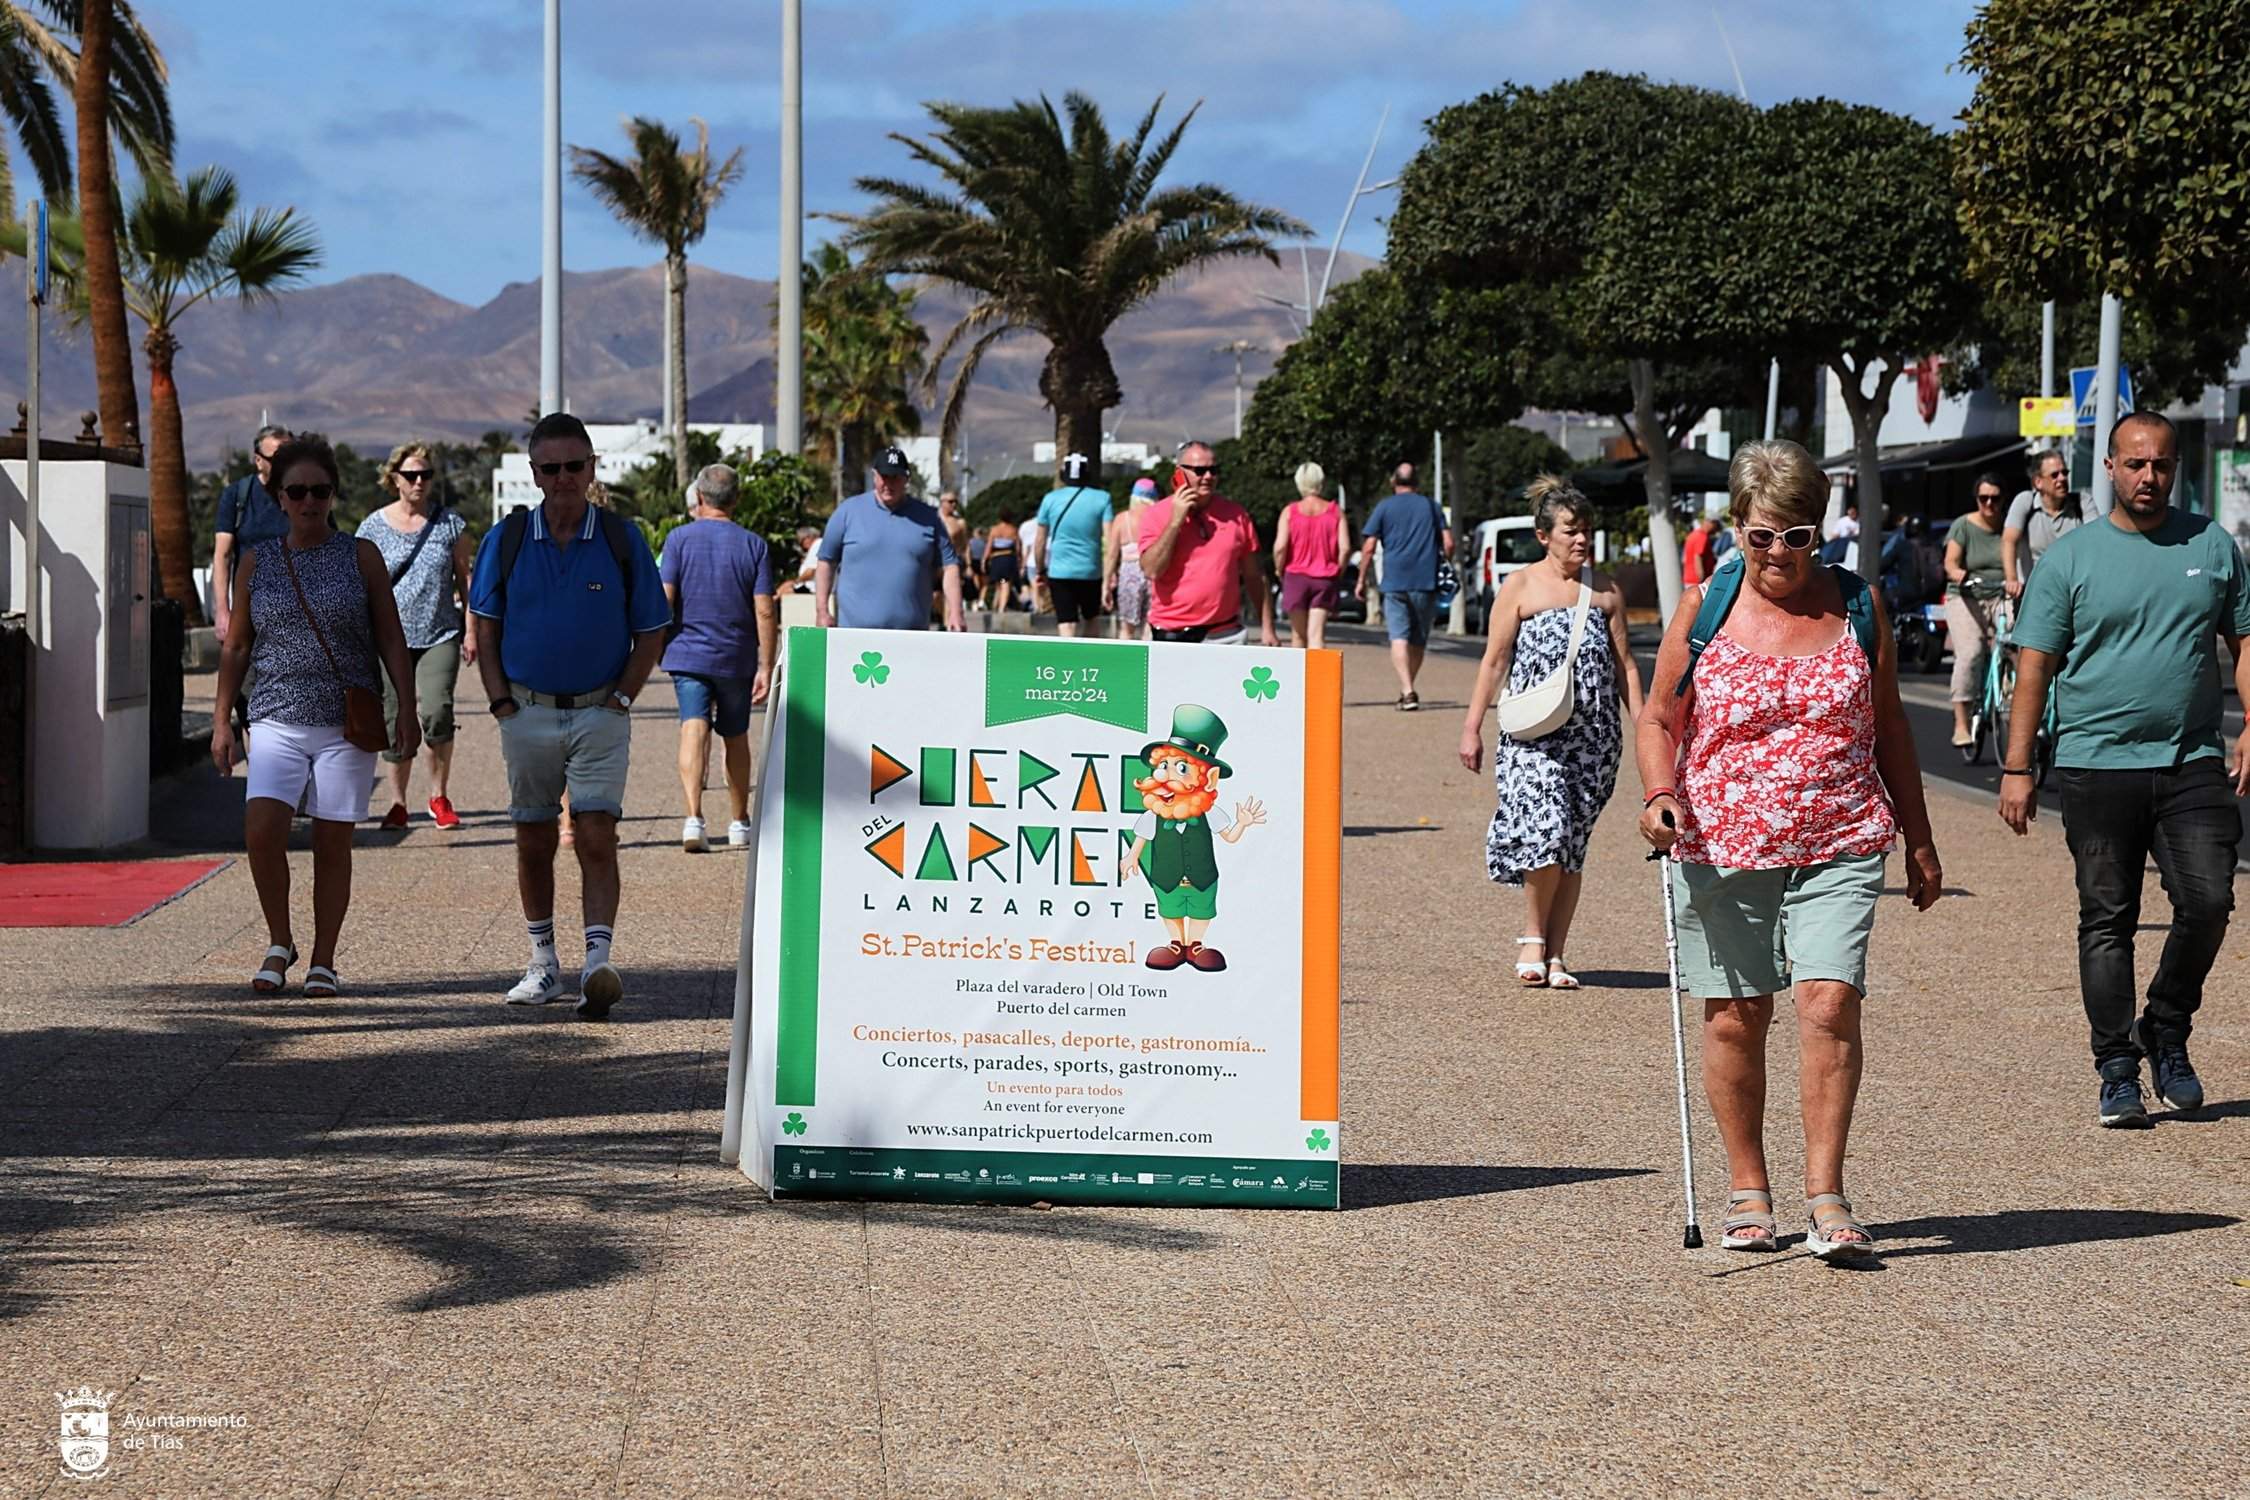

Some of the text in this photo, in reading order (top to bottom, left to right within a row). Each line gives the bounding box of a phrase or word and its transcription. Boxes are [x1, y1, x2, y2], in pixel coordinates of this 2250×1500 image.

[1036, 666, 1099, 685] 16 y 17
[1025, 686, 1108, 703] marzo'24
[862, 815, 892, 838] DEL
[864, 893, 1156, 919] LANZAROTE
[1029, 939, 1135, 963] Festival
[956, 979, 993, 993] Plaza
[997, 980, 1019, 993] del
[1023, 982, 1086, 996] varadero
[1097, 984, 1124, 997] Old
[1128, 985, 1167, 998] Town
[997, 1001, 1126, 1017] Puerto del carmen
[853, 1025, 1266, 1054] Conciertos, pasacalles, deporte, gastronomía...
[882, 1051, 1236, 1081] Concerts, parades, sports, gastronomy...
[987, 1081, 1123, 1098] Un evento para todos
[983, 1101, 1125, 1118] An event for everyone
[908, 1124, 1212, 1143] www.sanpatrickpuertodelcarmen.com
